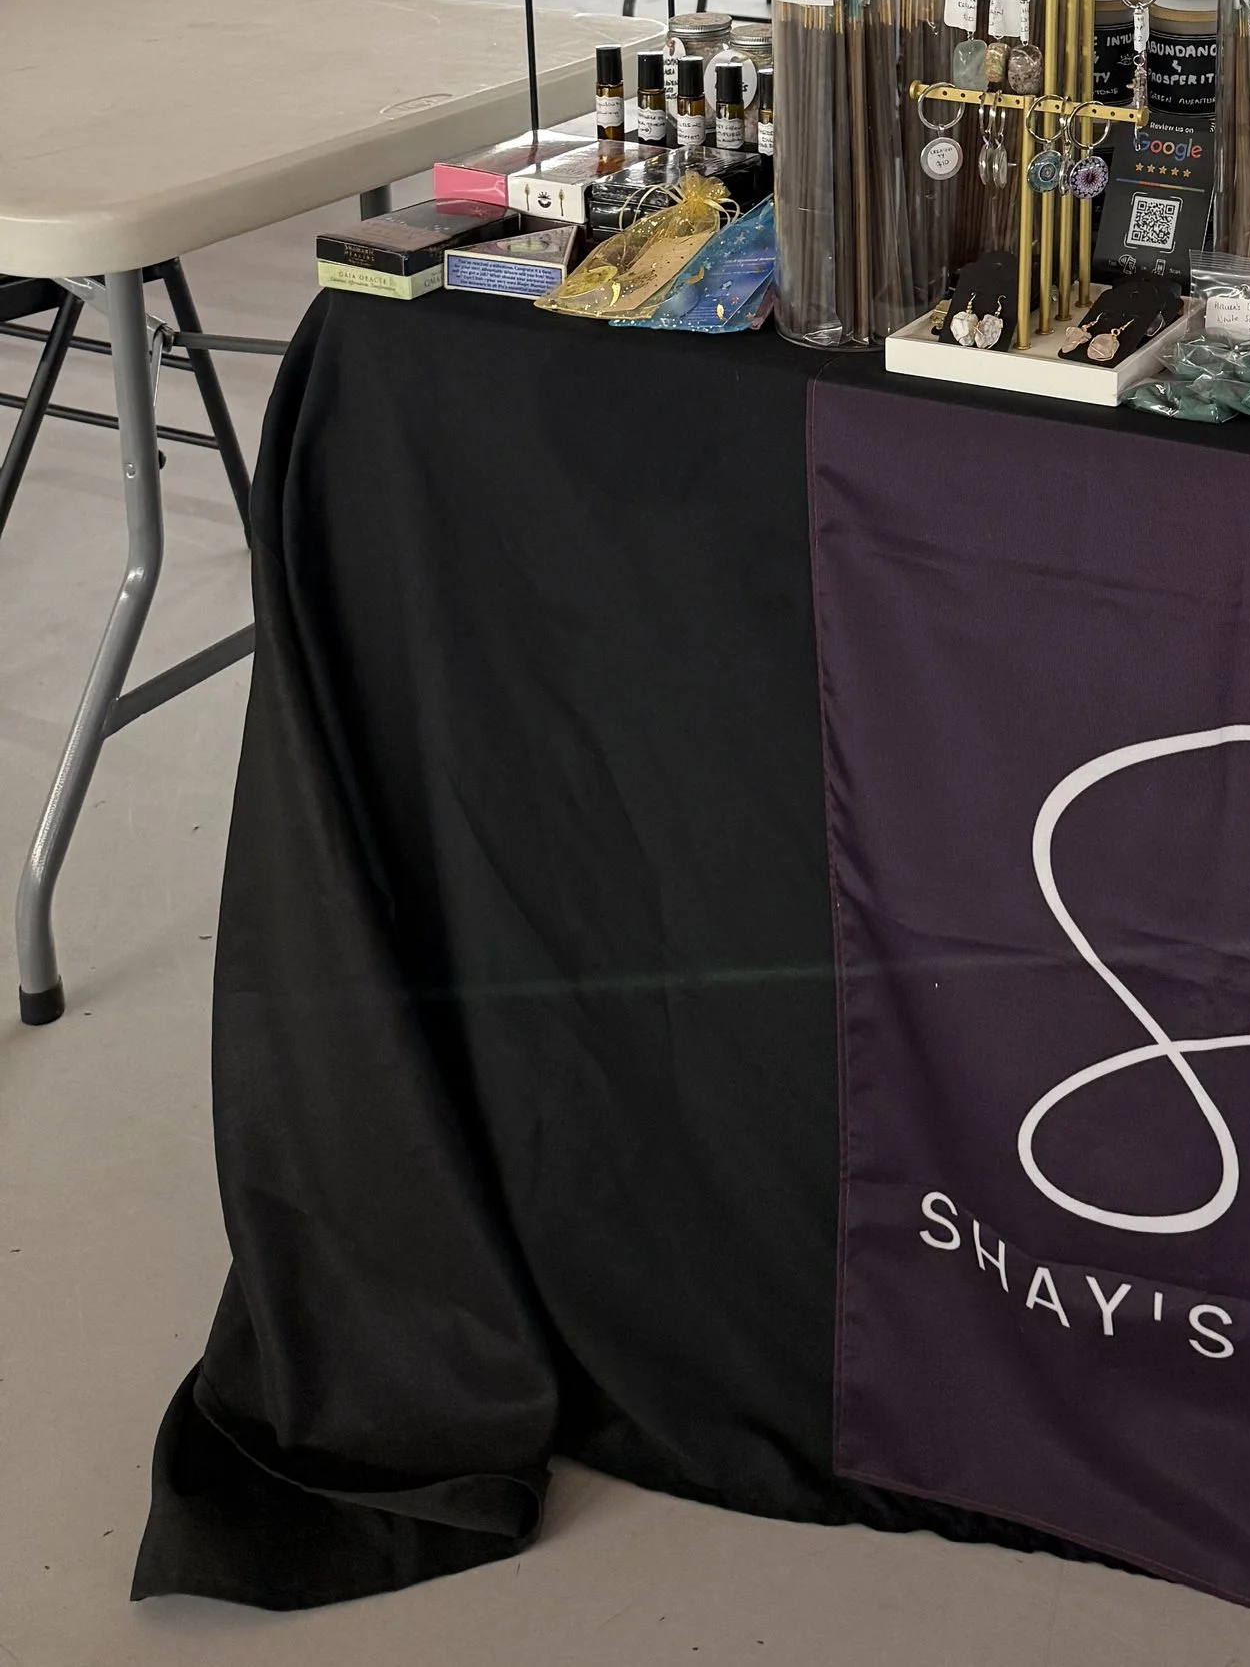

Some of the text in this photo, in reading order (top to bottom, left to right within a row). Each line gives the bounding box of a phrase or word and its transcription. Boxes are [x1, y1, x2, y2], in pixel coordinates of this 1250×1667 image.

[1150, 121, 1194, 134] Review us on
[1133, 132, 1203, 162] Google
[918, 1191, 1236, 1360] SHAY'S
